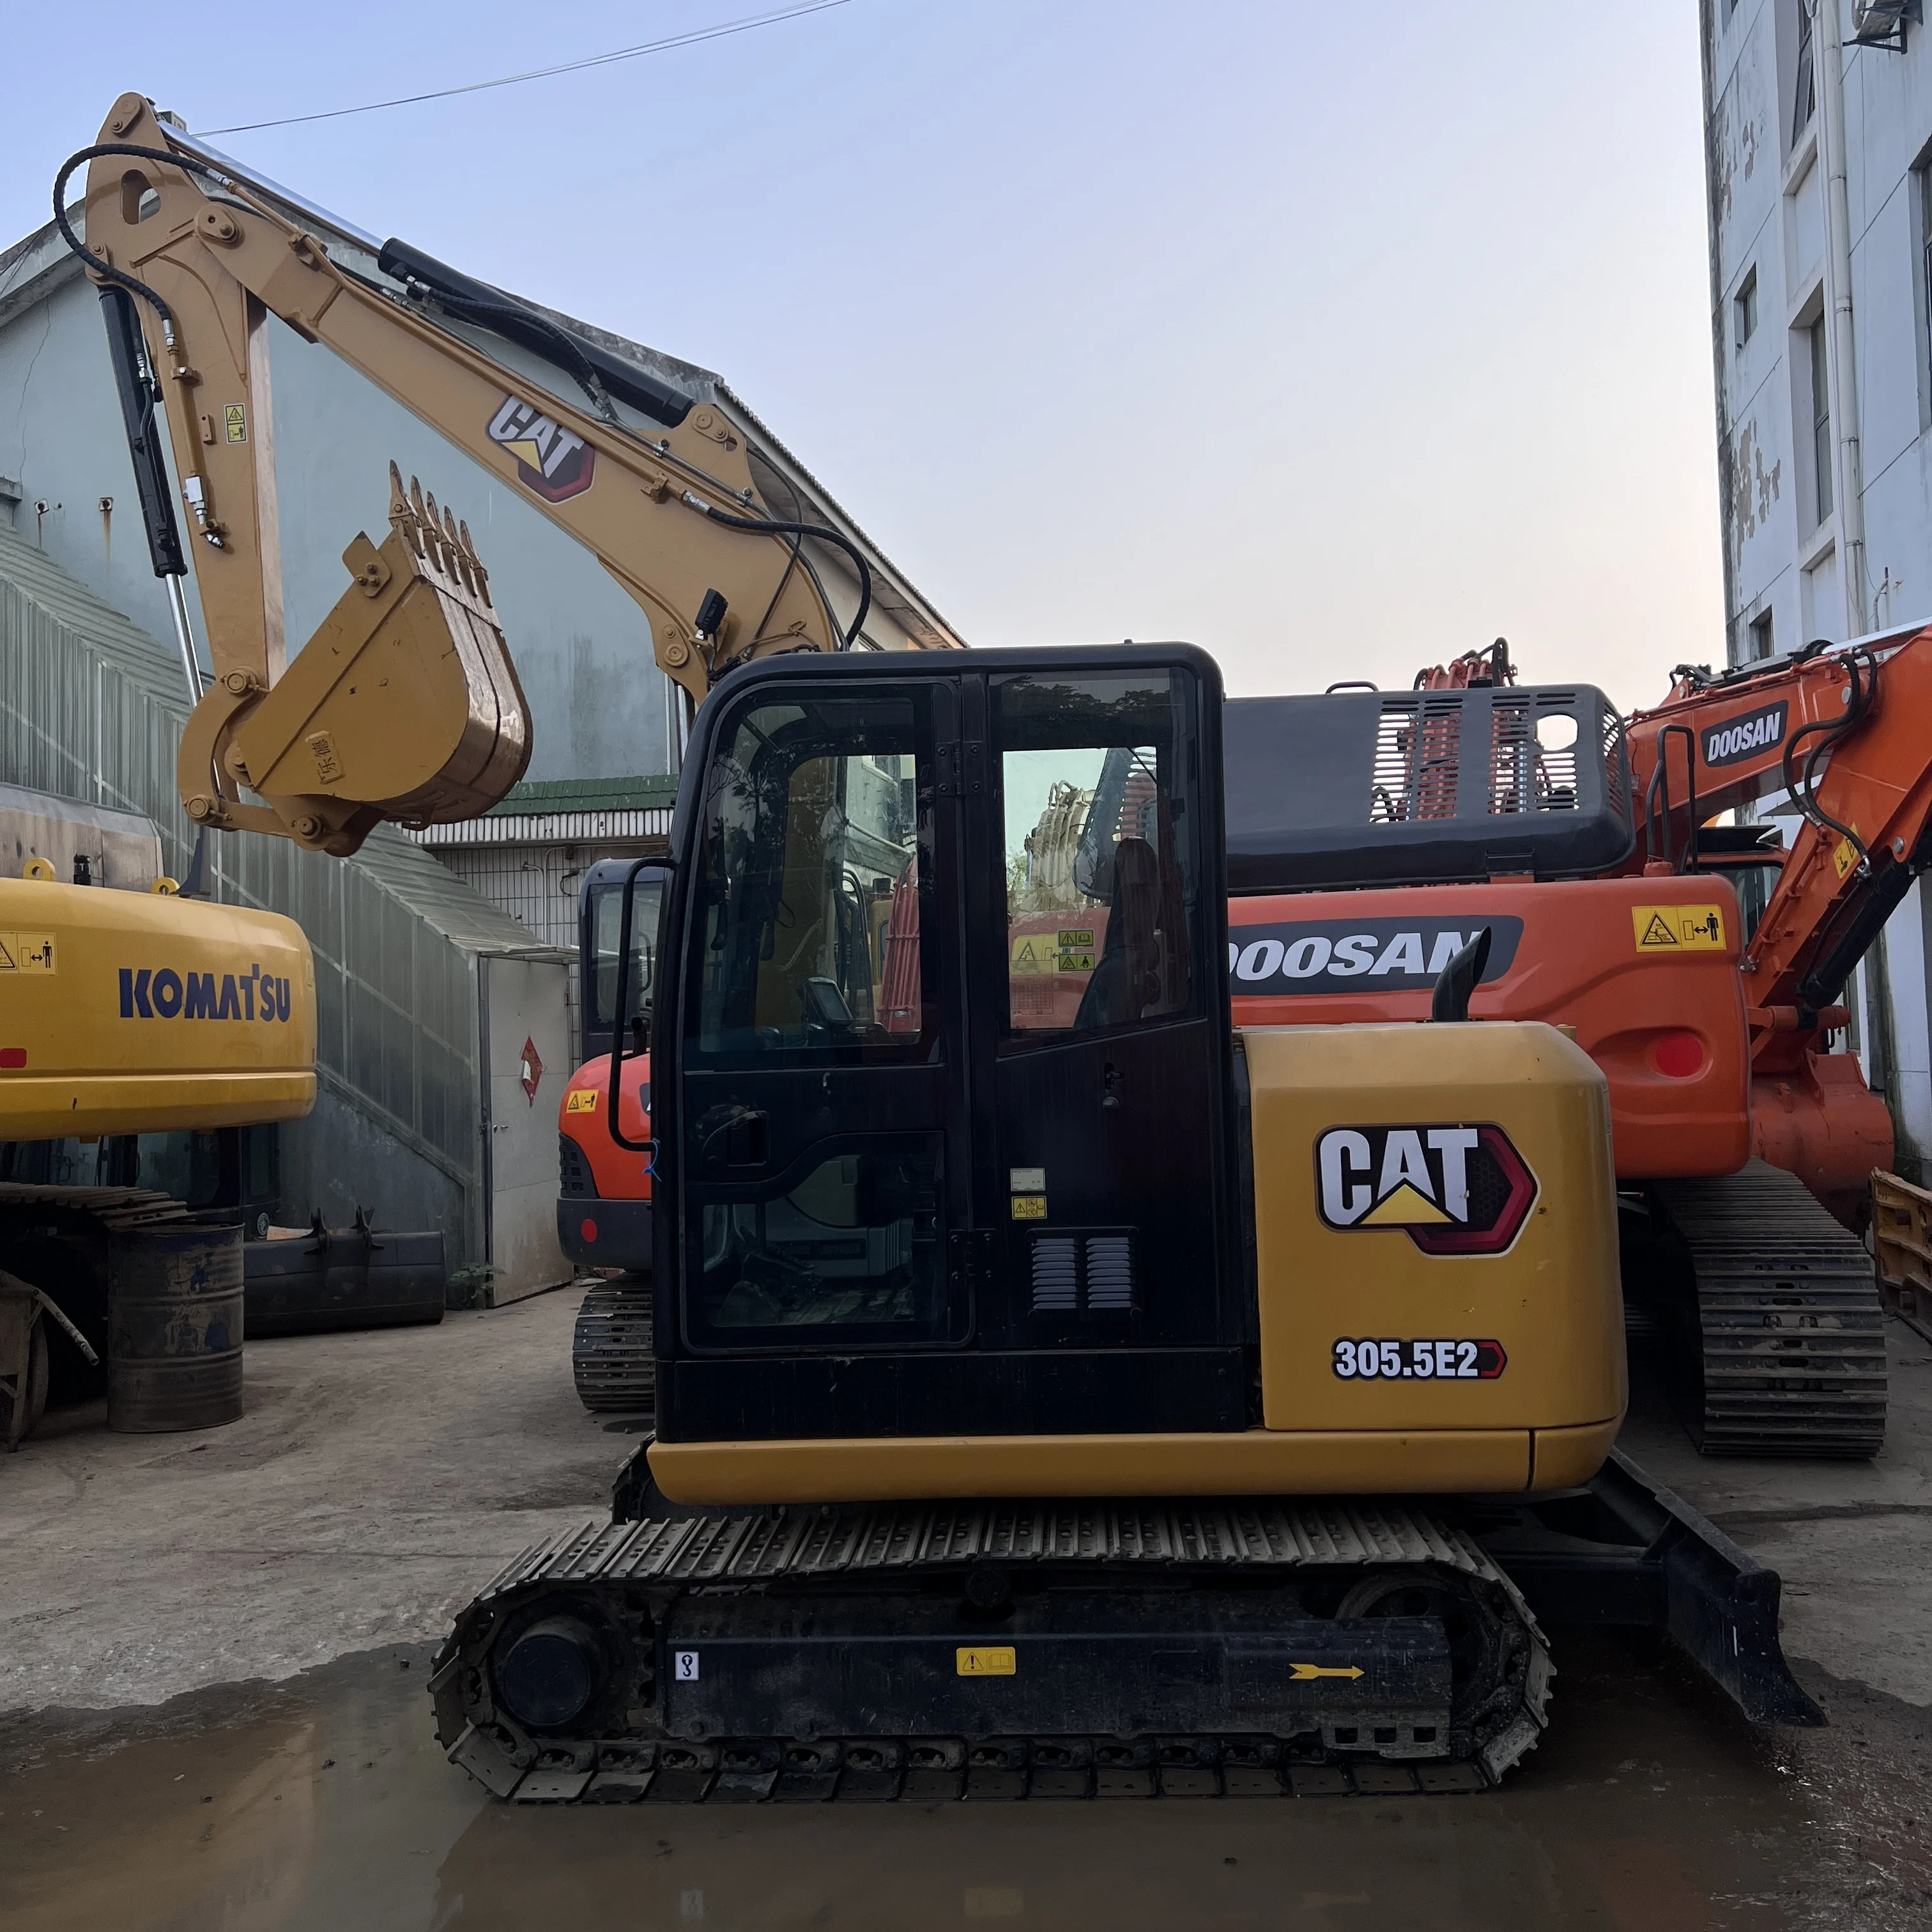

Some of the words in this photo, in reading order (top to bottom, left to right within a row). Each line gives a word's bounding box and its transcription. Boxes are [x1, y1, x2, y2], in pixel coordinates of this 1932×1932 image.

[489, 395, 585, 479] CAT
[1708, 711, 1781, 762] DOOSAN
[1229, 931, 1482, 981] OOSAN
[119, 963, 290, 1022] KOMATSU
[1320, 1128, 1478, 1225] CAT
[1336, 1342, 1478, 1376] 305.5E2
